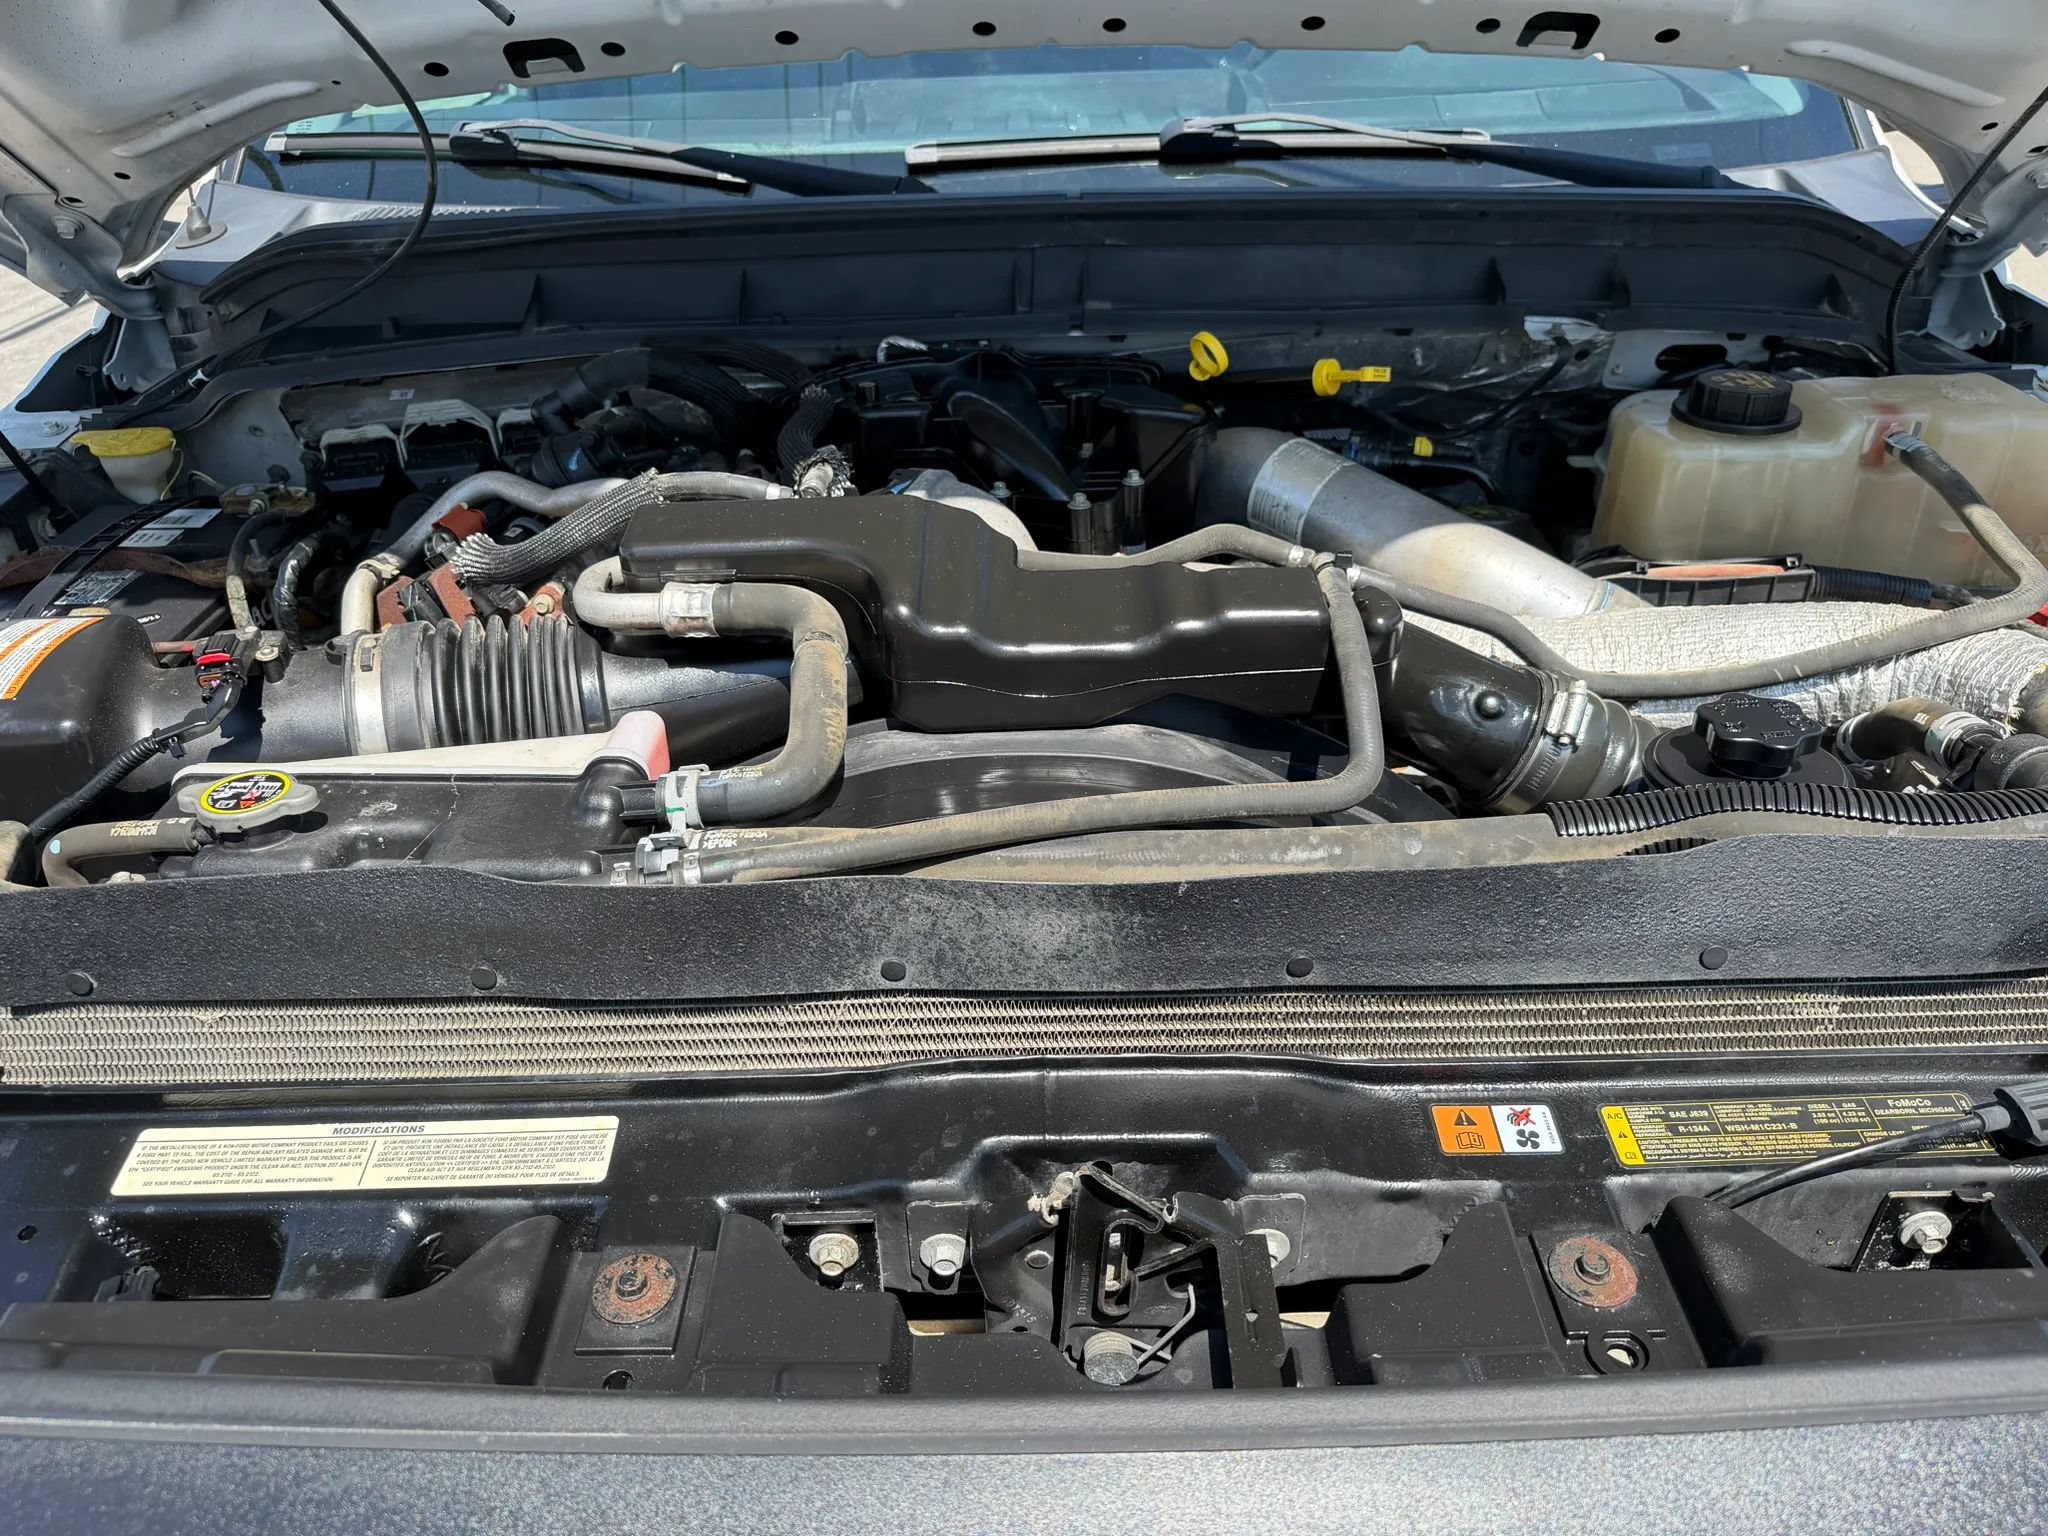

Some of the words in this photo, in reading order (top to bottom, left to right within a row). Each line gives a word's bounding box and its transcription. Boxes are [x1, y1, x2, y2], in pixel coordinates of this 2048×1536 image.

[1887, 1098, 1932, 1107] FoMoCo
[332, 1126, 425, 1134] MODIFICATIONS
[1724, 1123, 1798, 1131] WSH-M1C231-B
